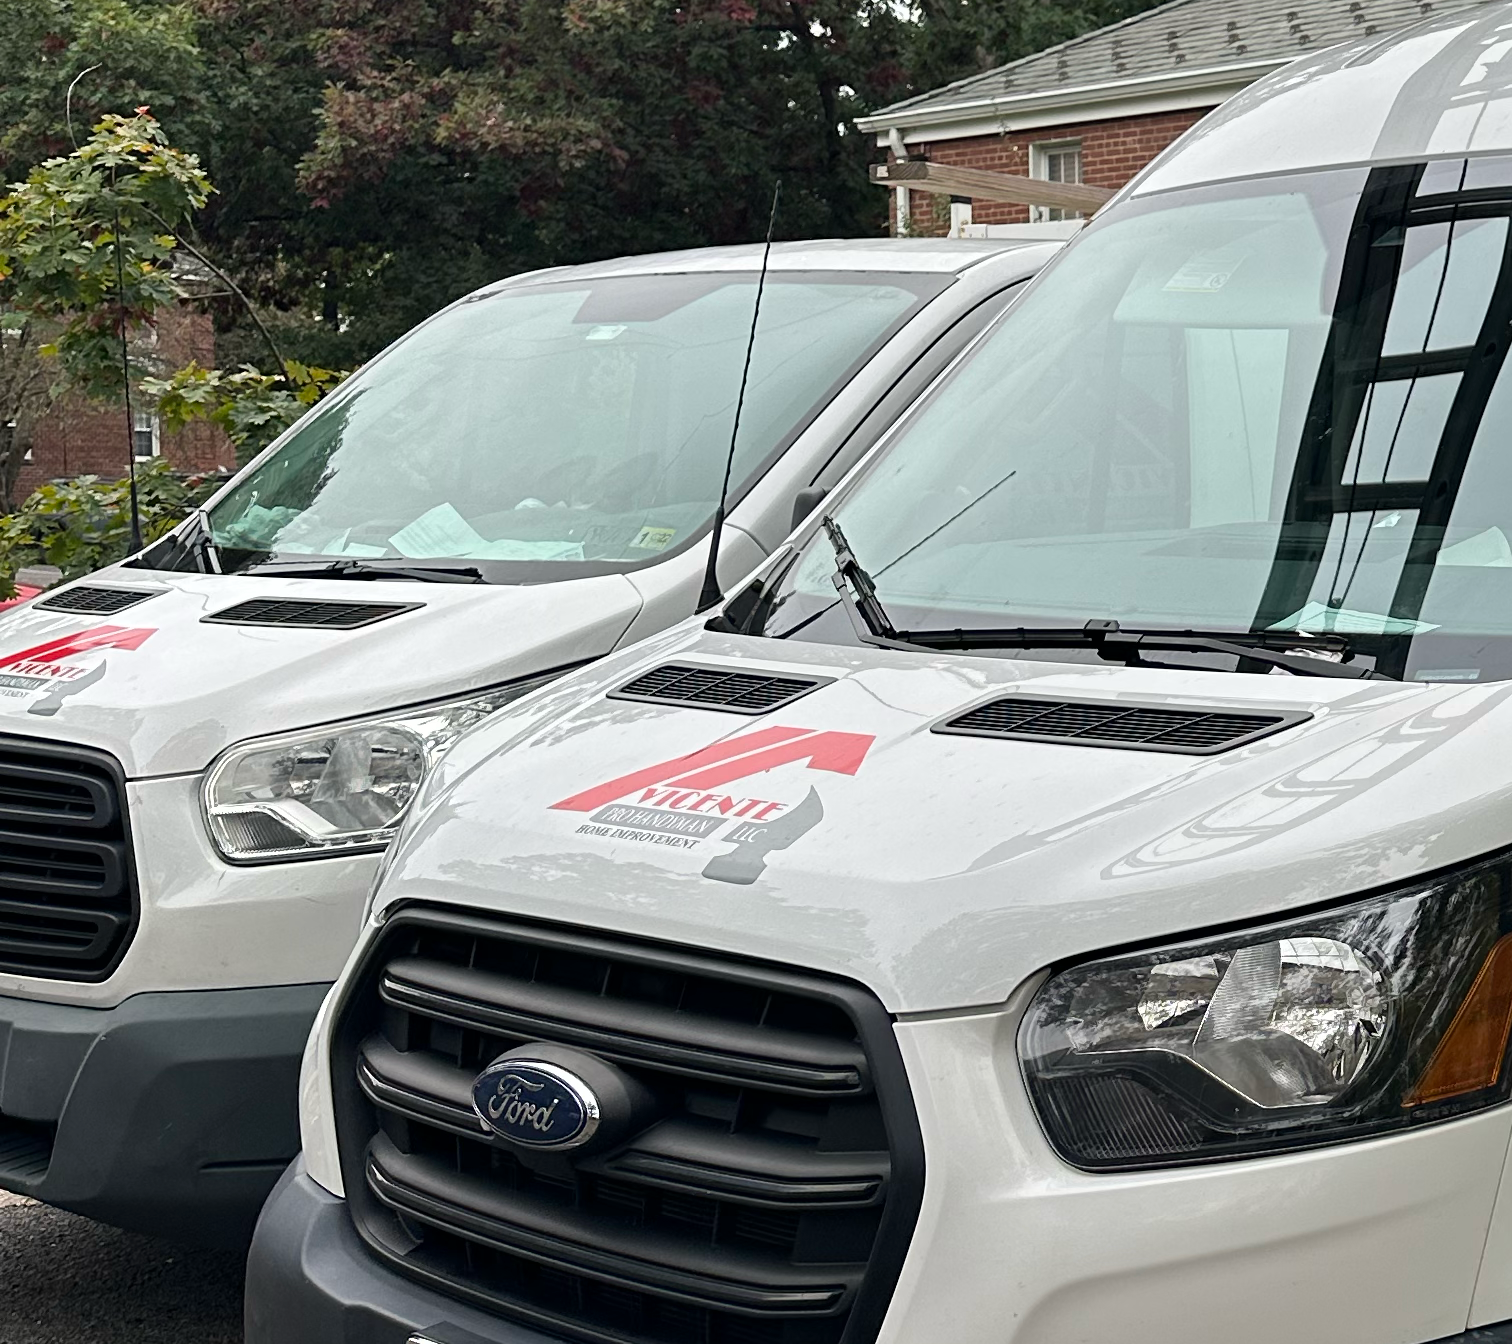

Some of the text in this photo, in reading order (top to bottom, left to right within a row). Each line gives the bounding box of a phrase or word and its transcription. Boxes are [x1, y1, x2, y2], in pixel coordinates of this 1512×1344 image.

[637, 787, 789, 822] VICENTE
[600, 806, 716, 834] PRO HANDYMAN
[732, 824, 768, 843] LLC
[575, 824, 701, 850] HOME IMPROVEMENT
[488, 1074, 559, 1132] Ford
